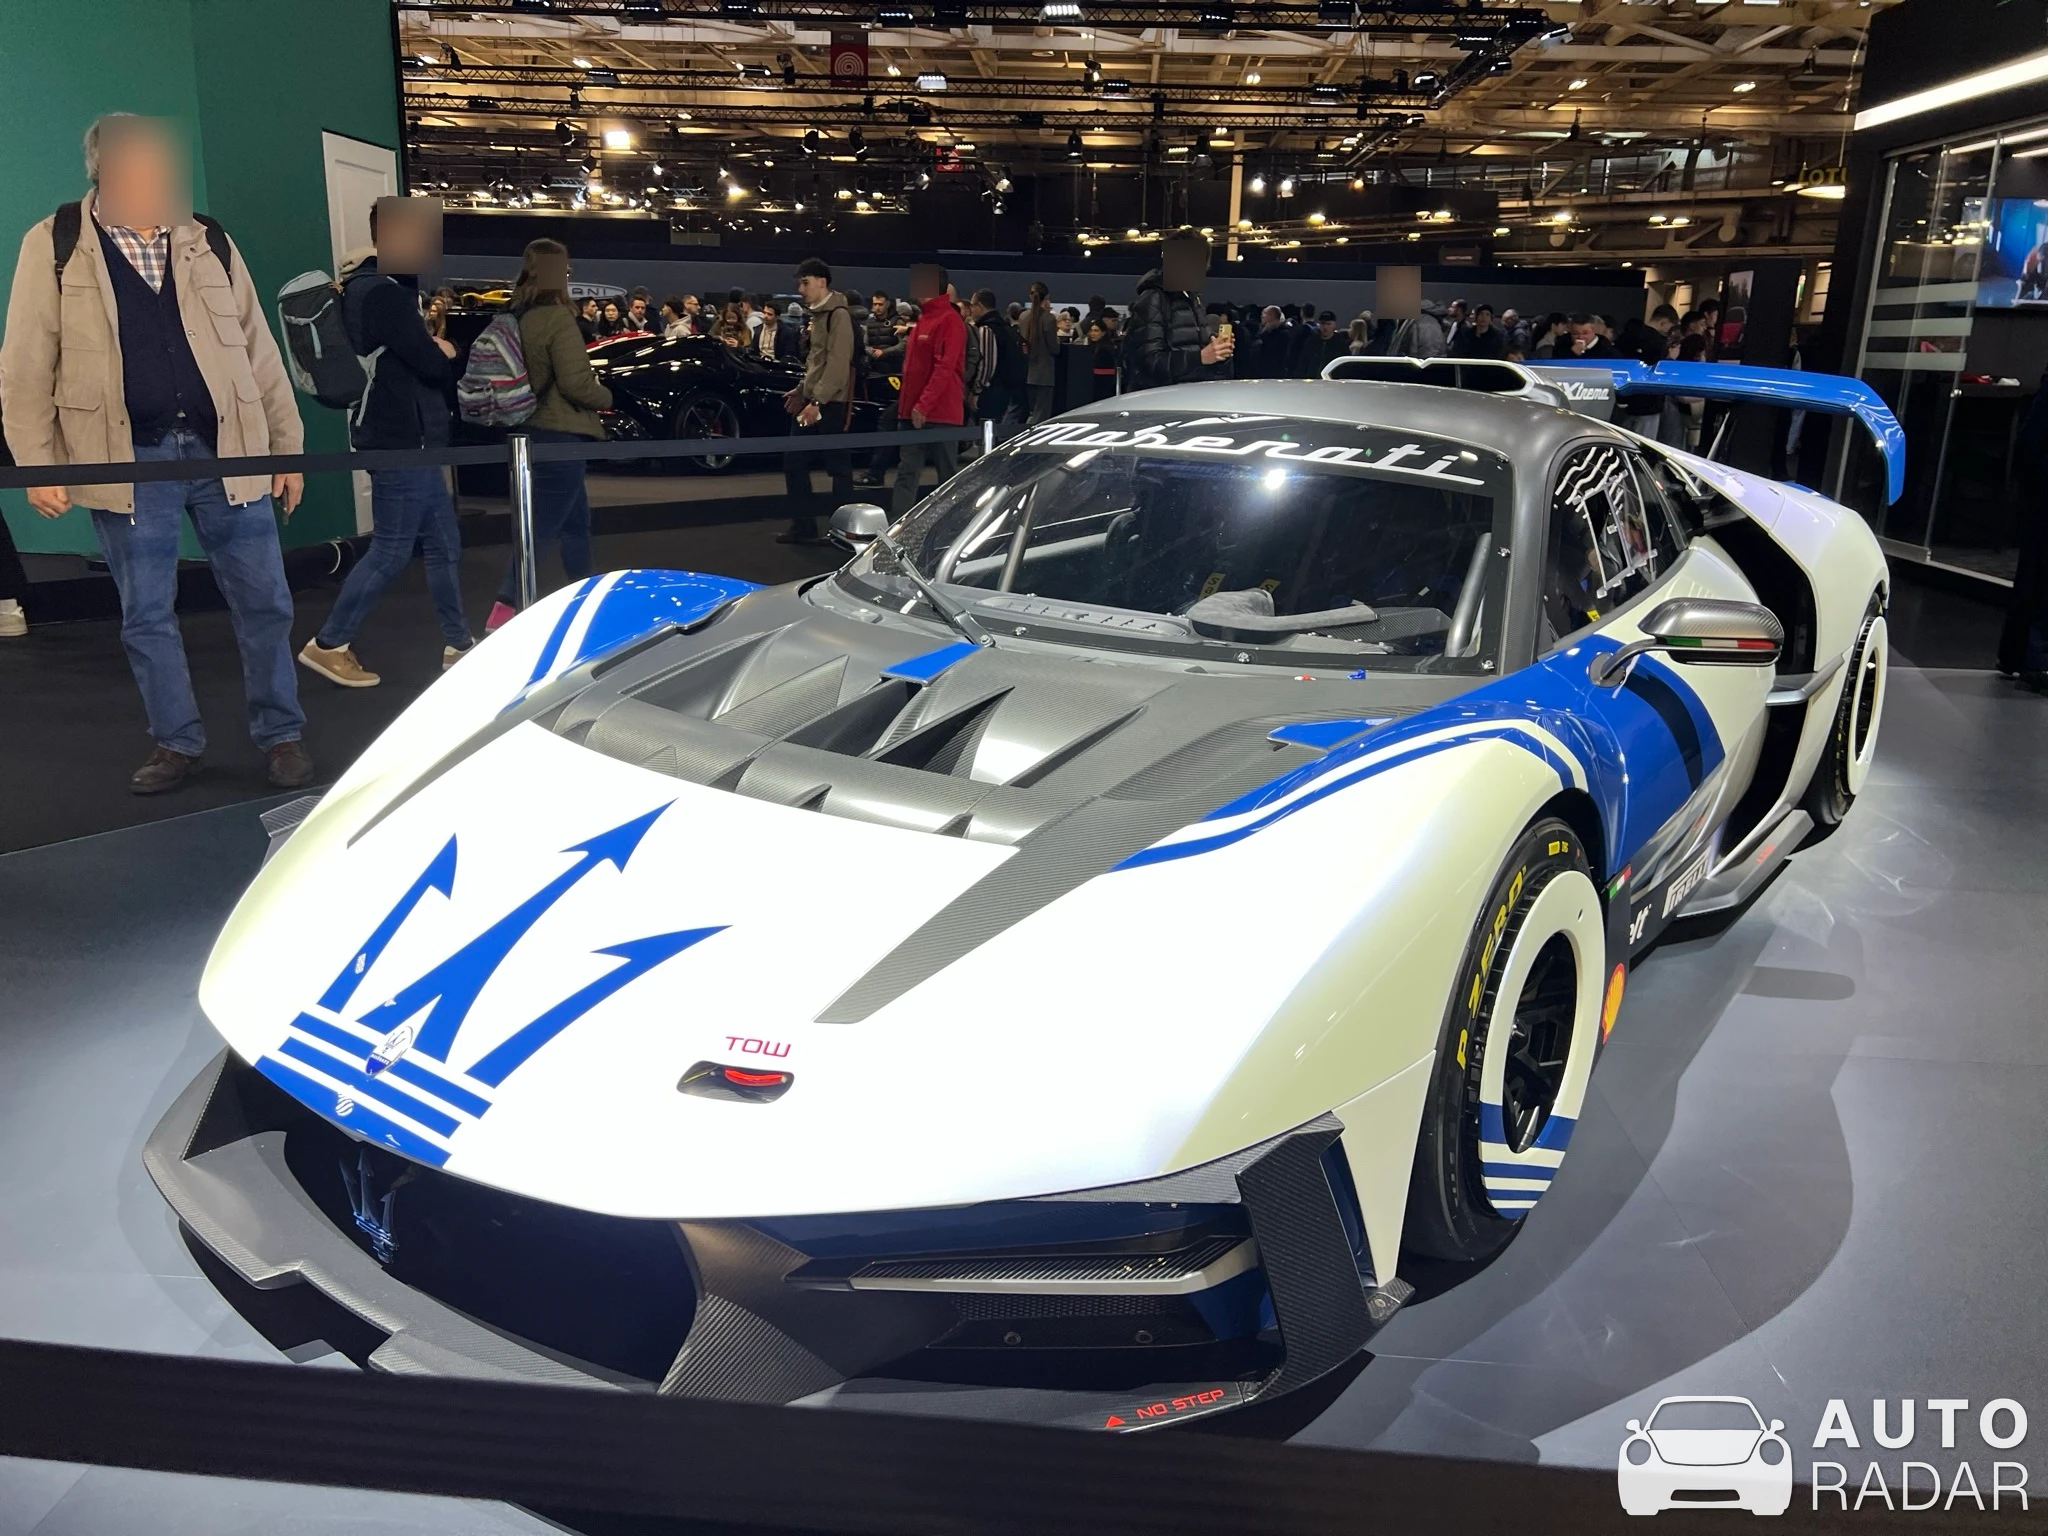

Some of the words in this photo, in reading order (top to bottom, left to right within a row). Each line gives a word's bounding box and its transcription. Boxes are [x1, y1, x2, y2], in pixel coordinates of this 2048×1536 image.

[1557, 381, 1610, 401] Xtrema
[1012, 421, 1485, 487] Maserati
[1661, 844, 1712, 919] PIRELLI
[1456, 1028, 1469, 1071] P
[1467, 869, 1524, 1019] ZERO
[725, 1035, 792, 1058] TOW
[1135, 1402, 1169, 1420] NO
[1171, 1388, 1226, 1412] STEP
